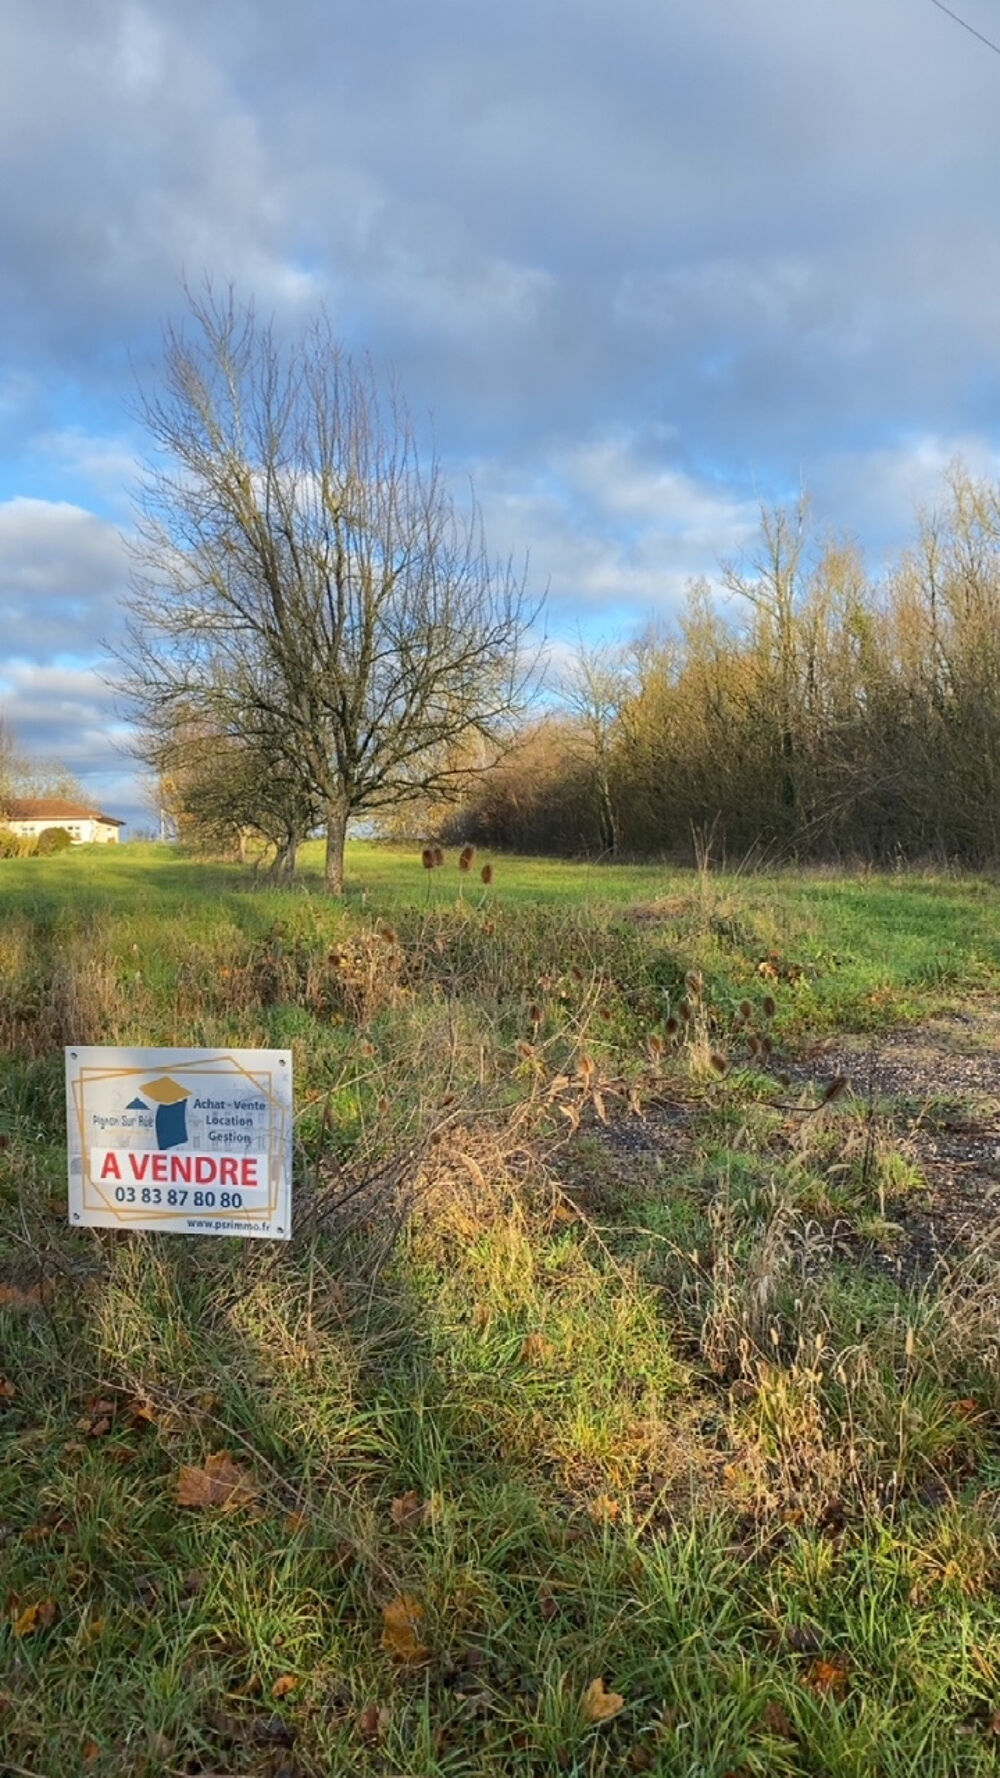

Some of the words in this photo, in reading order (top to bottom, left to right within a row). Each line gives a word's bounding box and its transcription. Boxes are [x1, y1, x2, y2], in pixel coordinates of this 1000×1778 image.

[193, 1098, 225, 1110] Achat
[233, 1100, 266, 1111] Vente
[206, 1115, 254, 1127] Location
[208, 1130, 252, 1143] Gestion
[100, 1151, 122, 1180] A
[128, 1153, 259, 1187] VENDRE
[115, 1186, 136, 1203] 03
[141, 1188, 162, 1204] 83
[167, 1189, 188, 1206] 87
[193, 1191, 216, 1207] 80
[220, 1192, 243, 1208] 80
[187, 1219, 271, 1232] www.psrimmo.fr
